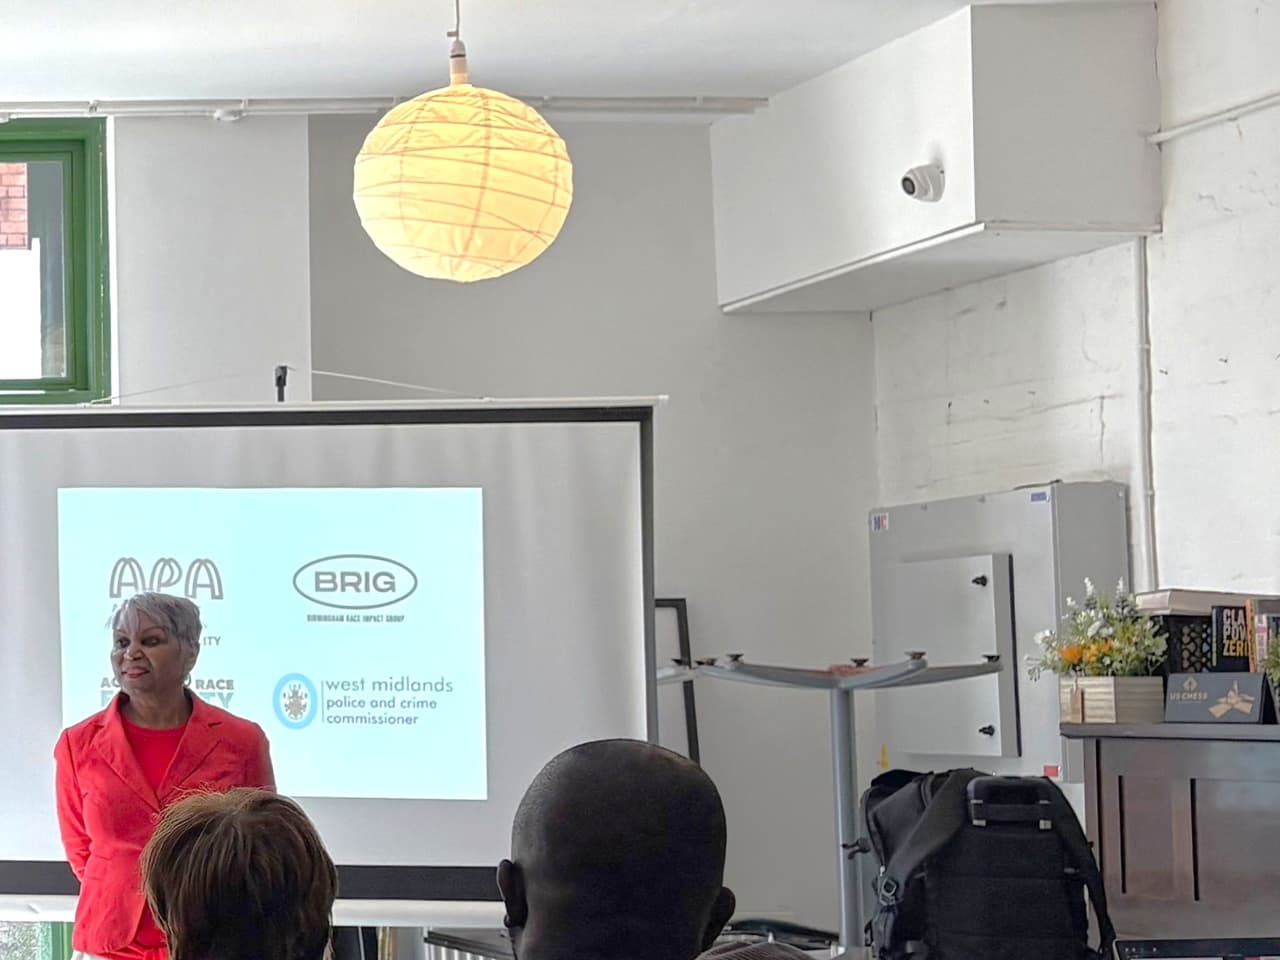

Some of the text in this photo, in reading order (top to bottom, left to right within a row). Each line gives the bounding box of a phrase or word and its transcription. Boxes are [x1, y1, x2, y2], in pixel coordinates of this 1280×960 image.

[109, 557, 224, 600] APA
[314, 570, 397, 593] BRIG
[195, 679, 235, 690] RACE
[325, 676, 454, 693] west midlands
[327, 696, 438, 710] police and crime
[326, 712, 419, 725] commissioner
